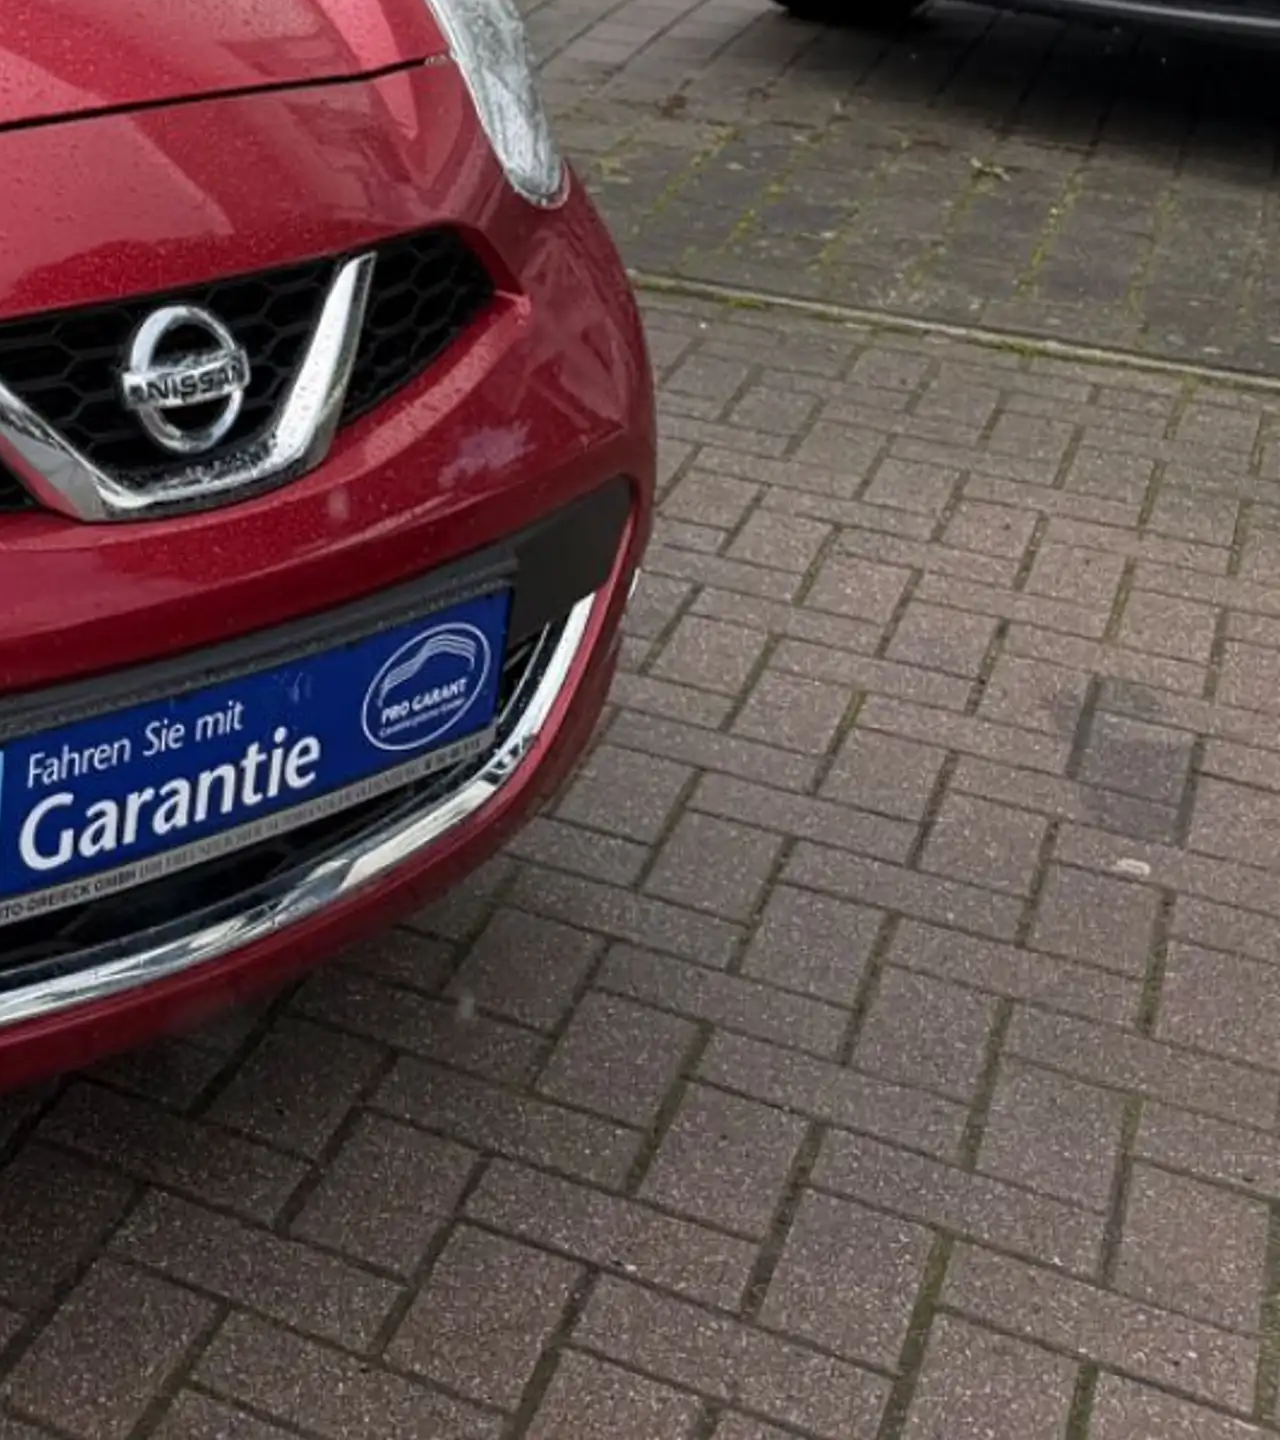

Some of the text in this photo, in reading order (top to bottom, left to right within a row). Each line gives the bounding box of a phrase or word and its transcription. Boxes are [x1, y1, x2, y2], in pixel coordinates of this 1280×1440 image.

[146, 362, 243, 401] NISSAN
[382, 700, 411, 725] PRO
[411, 677, 468, 712] GARANT
[27, 701, 245, 789] Fahren Sie mit
[18, 726, 322, 872] Garantie
[27, 882, 91, 914] DREIECK
